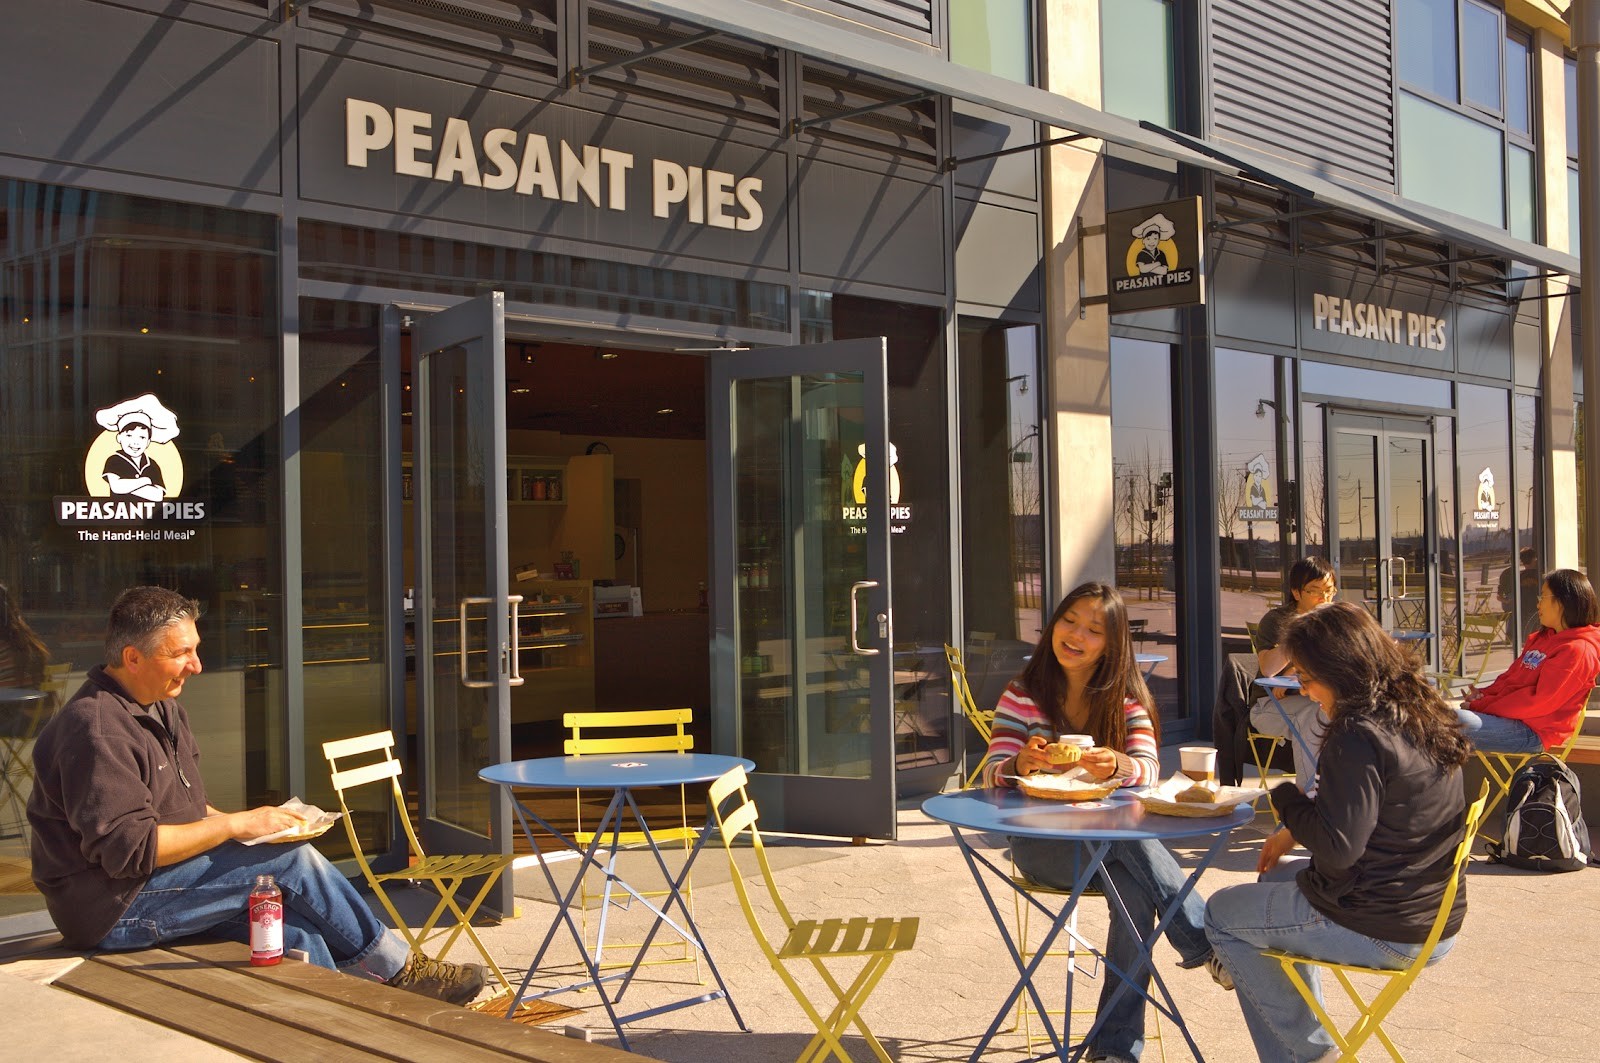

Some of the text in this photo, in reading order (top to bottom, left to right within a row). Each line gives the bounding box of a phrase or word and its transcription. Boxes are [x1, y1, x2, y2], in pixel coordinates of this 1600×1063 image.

[346, 97, 764, 233] PEASANT PIES
[1116, 270, 1191, 291] PEASANT PIES
[1313, 293, 1446, 351] PEASANT PIES
[61, 501, 205, 520] PEASANT PIES
[842, 507, 911, 520] PEAS PIES
[1239, 509, 1277, 519] PEASANT PIES
[78, 530, 99, 541] The
[102, 530, 161, 541] Hand-Held
[851, 526, 861, 534] The
[253, 903, 279, 914] SYNERGY
